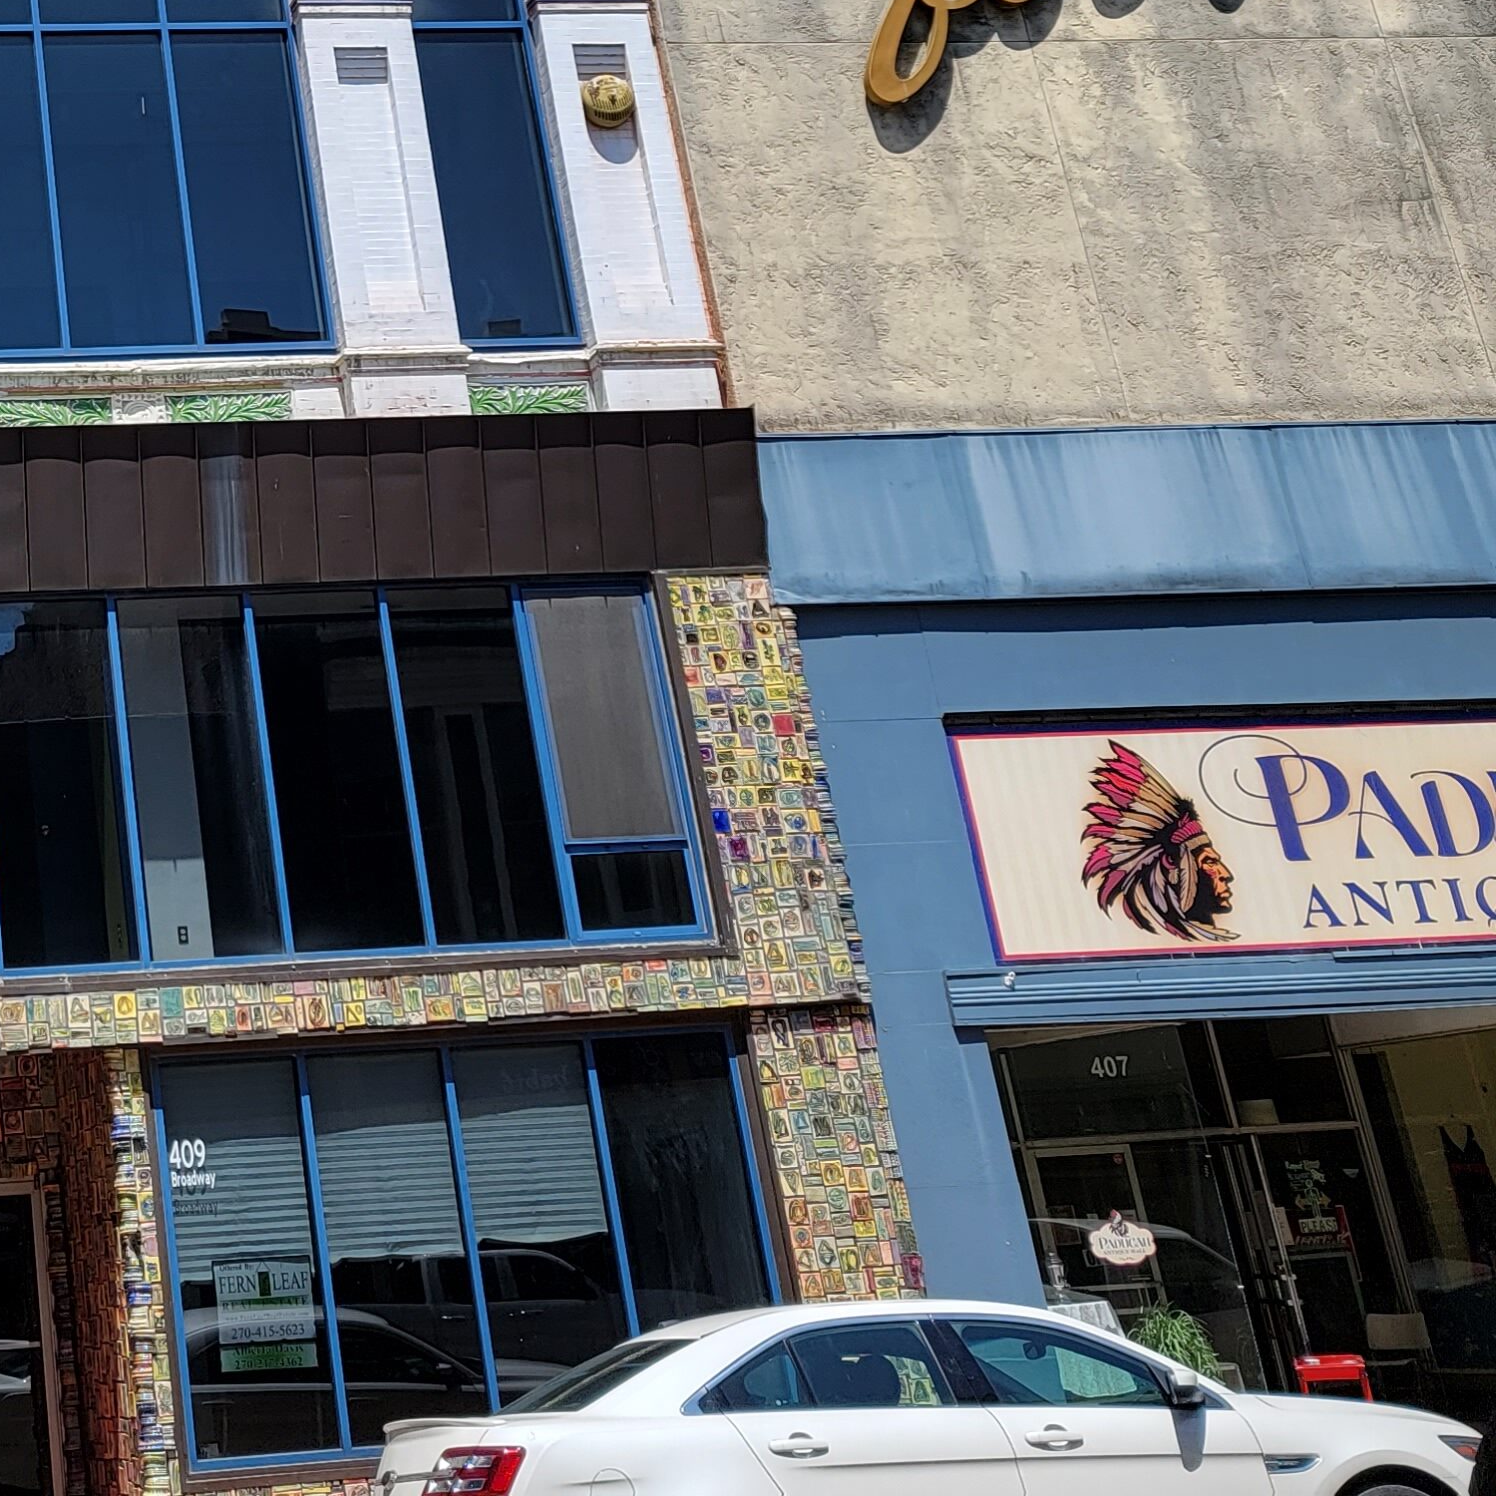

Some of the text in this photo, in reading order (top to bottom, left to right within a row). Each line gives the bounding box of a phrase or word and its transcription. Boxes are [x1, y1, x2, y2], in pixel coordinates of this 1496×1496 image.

[1199, 734, 1496, 862] PAD
[1090, 1055, 1129, 1079] 407
[169, 1139, 206, 1169] 409
[171, 1169, 216, 1189] Broadway
[1098, 1237, 1151, 1250] PADUCAH
[218, 1272, 309, 1294] FERN LEAF
[231, 1323, 305, 1340] 270-415-5623
